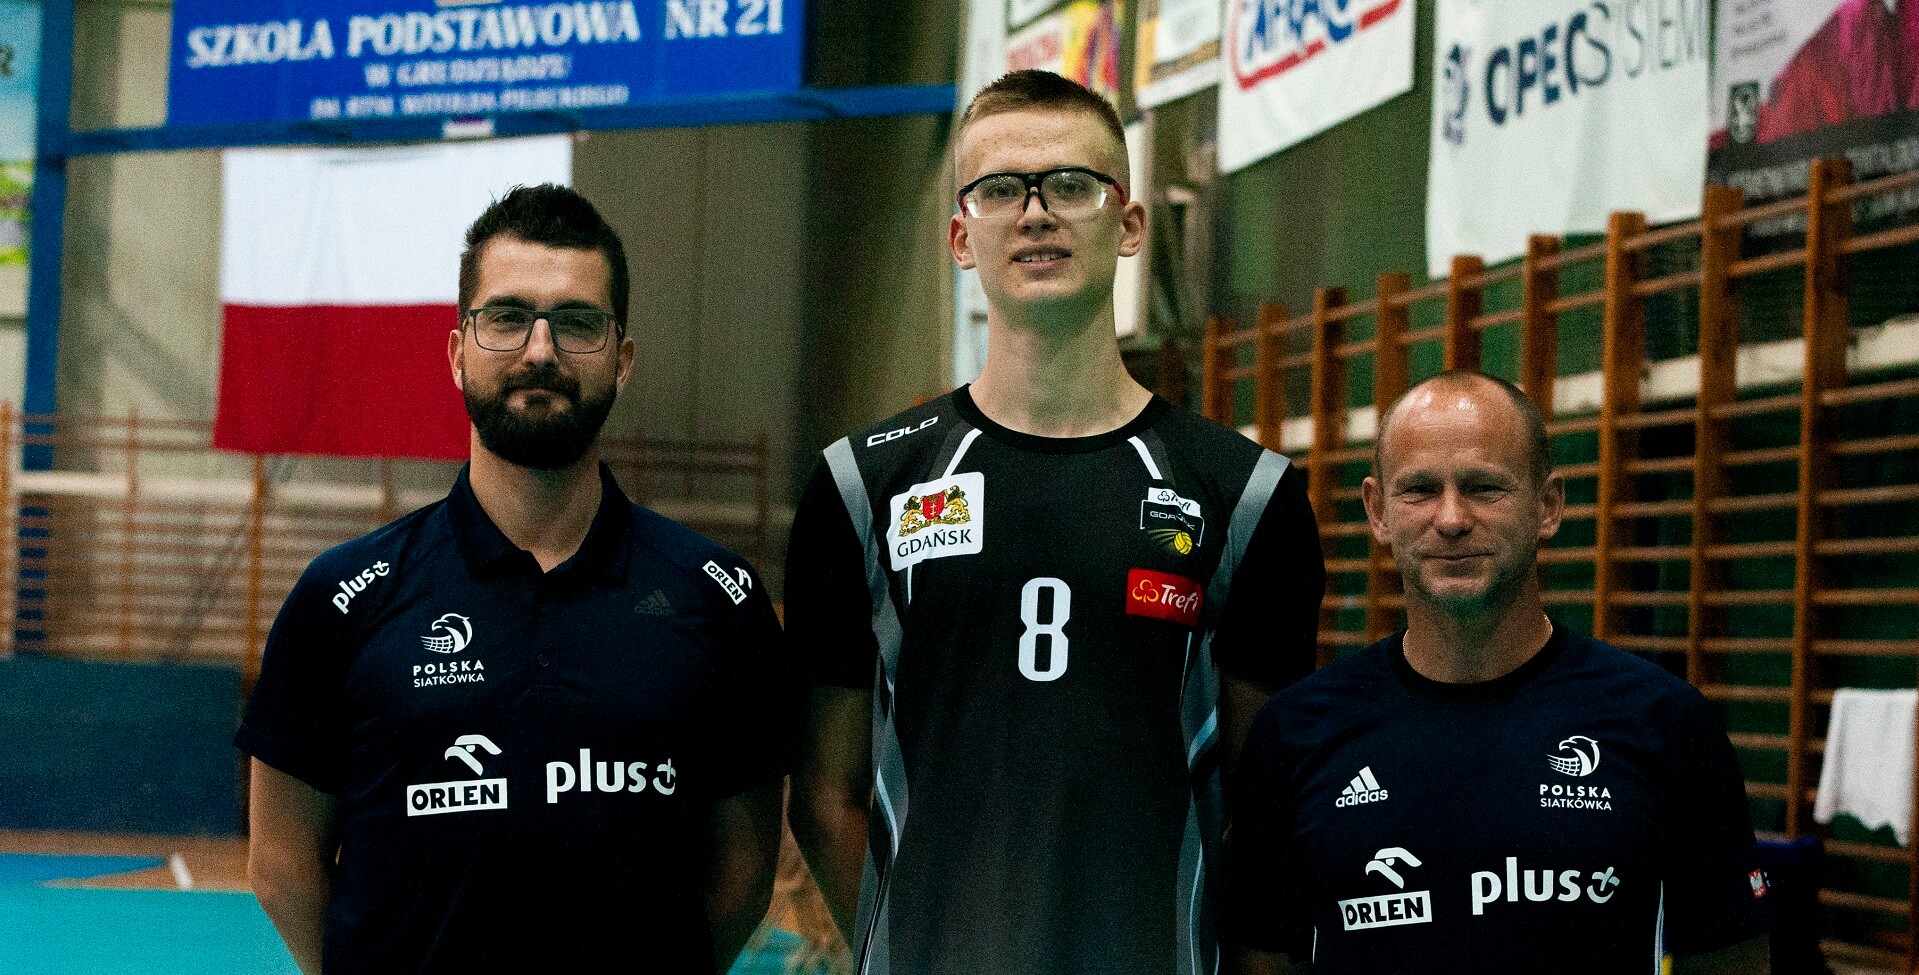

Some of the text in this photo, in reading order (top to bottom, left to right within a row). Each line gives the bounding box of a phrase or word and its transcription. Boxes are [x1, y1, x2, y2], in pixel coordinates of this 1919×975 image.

[347, 0, 641, 57] PODSTAWOWA
[664, 0, 729, 40] NR
[734, 0, 784, 35] 21
[897, 529, 972, 557] GDAŃSK
[707, 564, 743, 601] ORLEN
[1018, 577, 1071, 682] 8
[413, 660, 484, 676] POLSKA
[413, 673, 485, 688] SIATKÓWKA
[411, 783, 500, 811] ORLEN
[1335, 789, 1389, 808] adidas
[1539, 783, 1612, 799] POLSKA
[1540, 797, 1612, 811] SIATKÓWKA
[1345, 896, 1425, 926] ORLEN
